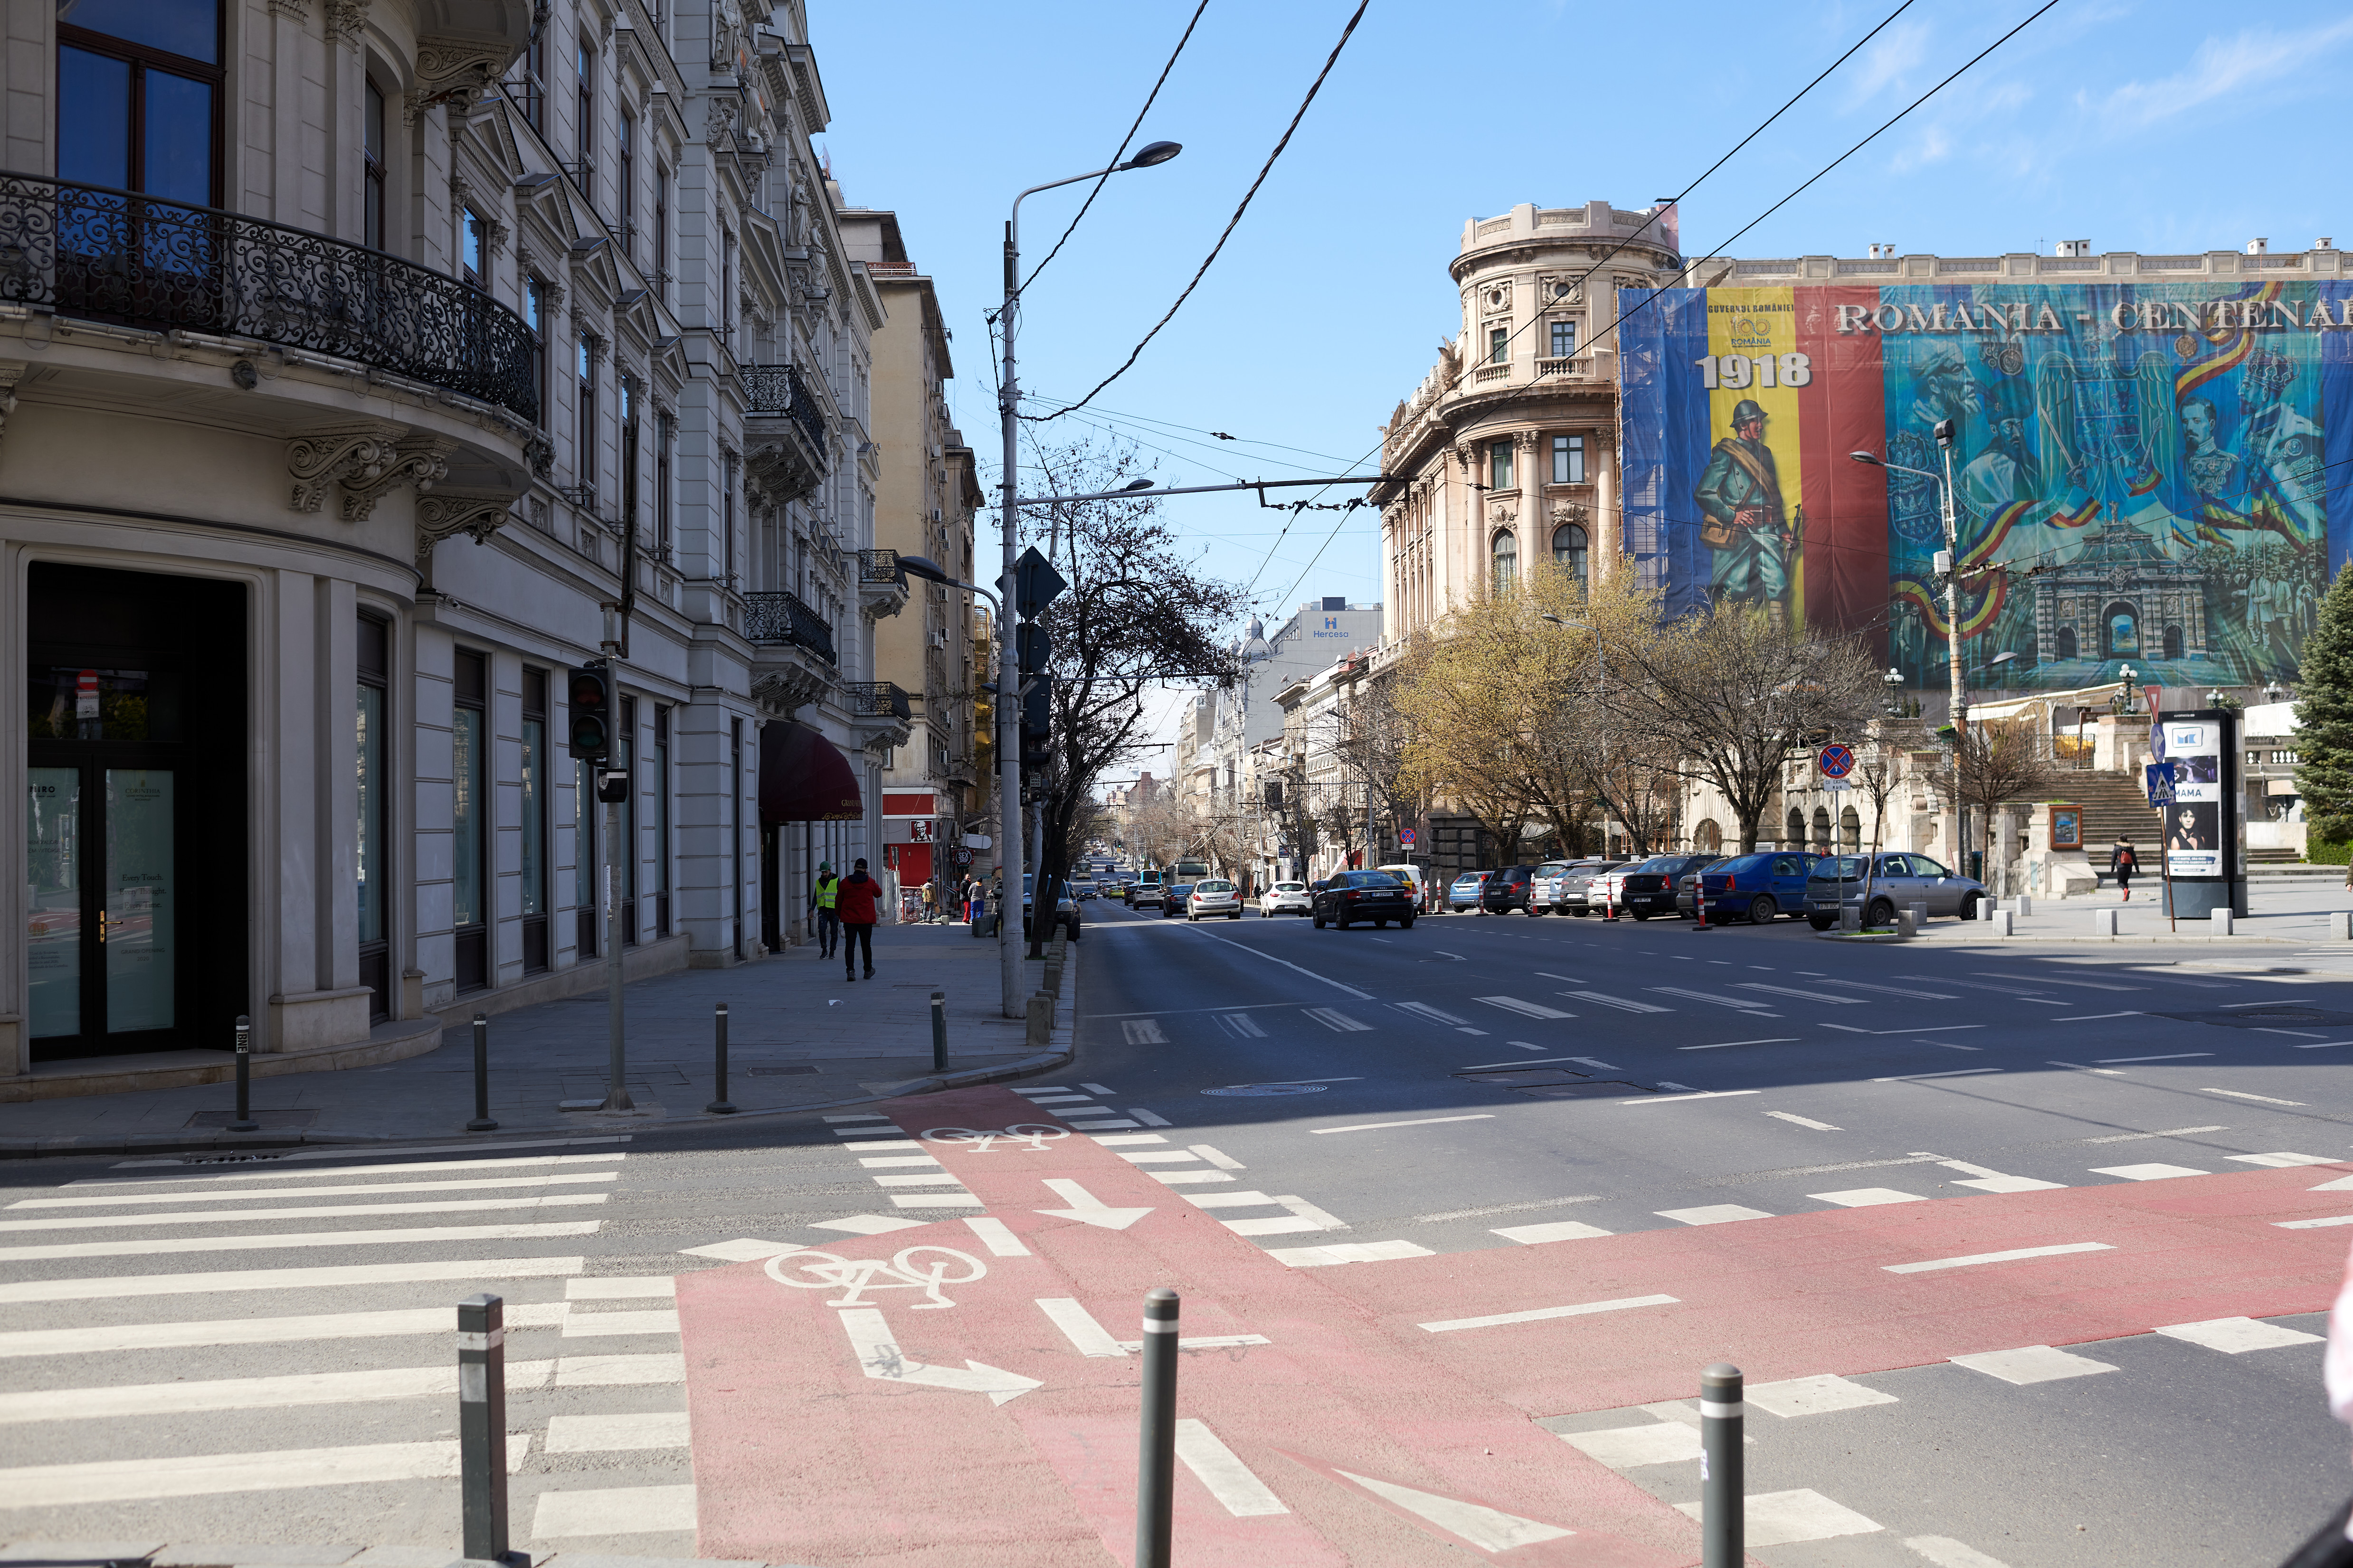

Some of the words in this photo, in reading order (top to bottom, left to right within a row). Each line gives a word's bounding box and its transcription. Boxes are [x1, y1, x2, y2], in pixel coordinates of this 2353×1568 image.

[1708, 305, 1751, 313] GUVERNUL
[1753, 303, 1794, 312] ROMÂNIEI
[1834, 299, 2065, 331] ROMÂNIA
[1731, 337, 1771, 345] ROMÂNIA
[1694, 352, 1811, 389] 1918
[122, 874, 140, 883] Every
[119, 888, 137, 897] Every
[138, 887, 166, 896] Thought.
[124, 902, 141, 910] Every
[237, 1034, 247, 1051] BNE
